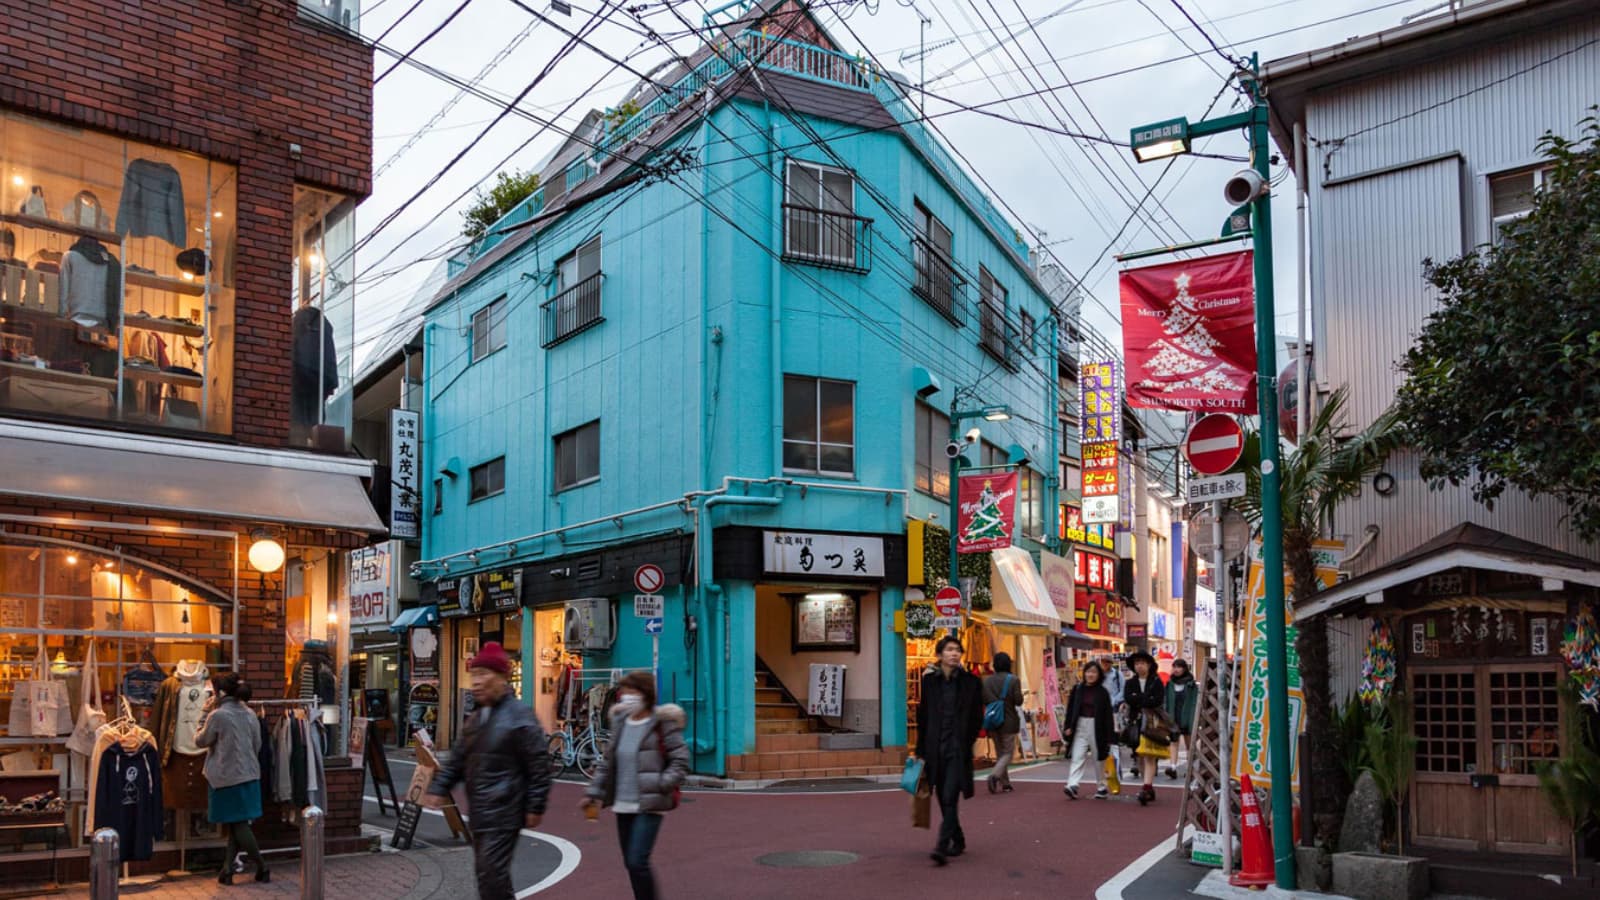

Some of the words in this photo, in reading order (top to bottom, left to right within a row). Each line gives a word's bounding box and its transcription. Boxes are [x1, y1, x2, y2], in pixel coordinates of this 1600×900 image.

[1138, 308, 1167, 319] Merry
[1198, 297, 1240, 310] Christmas
[1206, 398, 1246, 408] SOUTH
[1085, 472, 1115, 484] ゲーム
[1190, 479, 1242, 498] 自転車を除く
